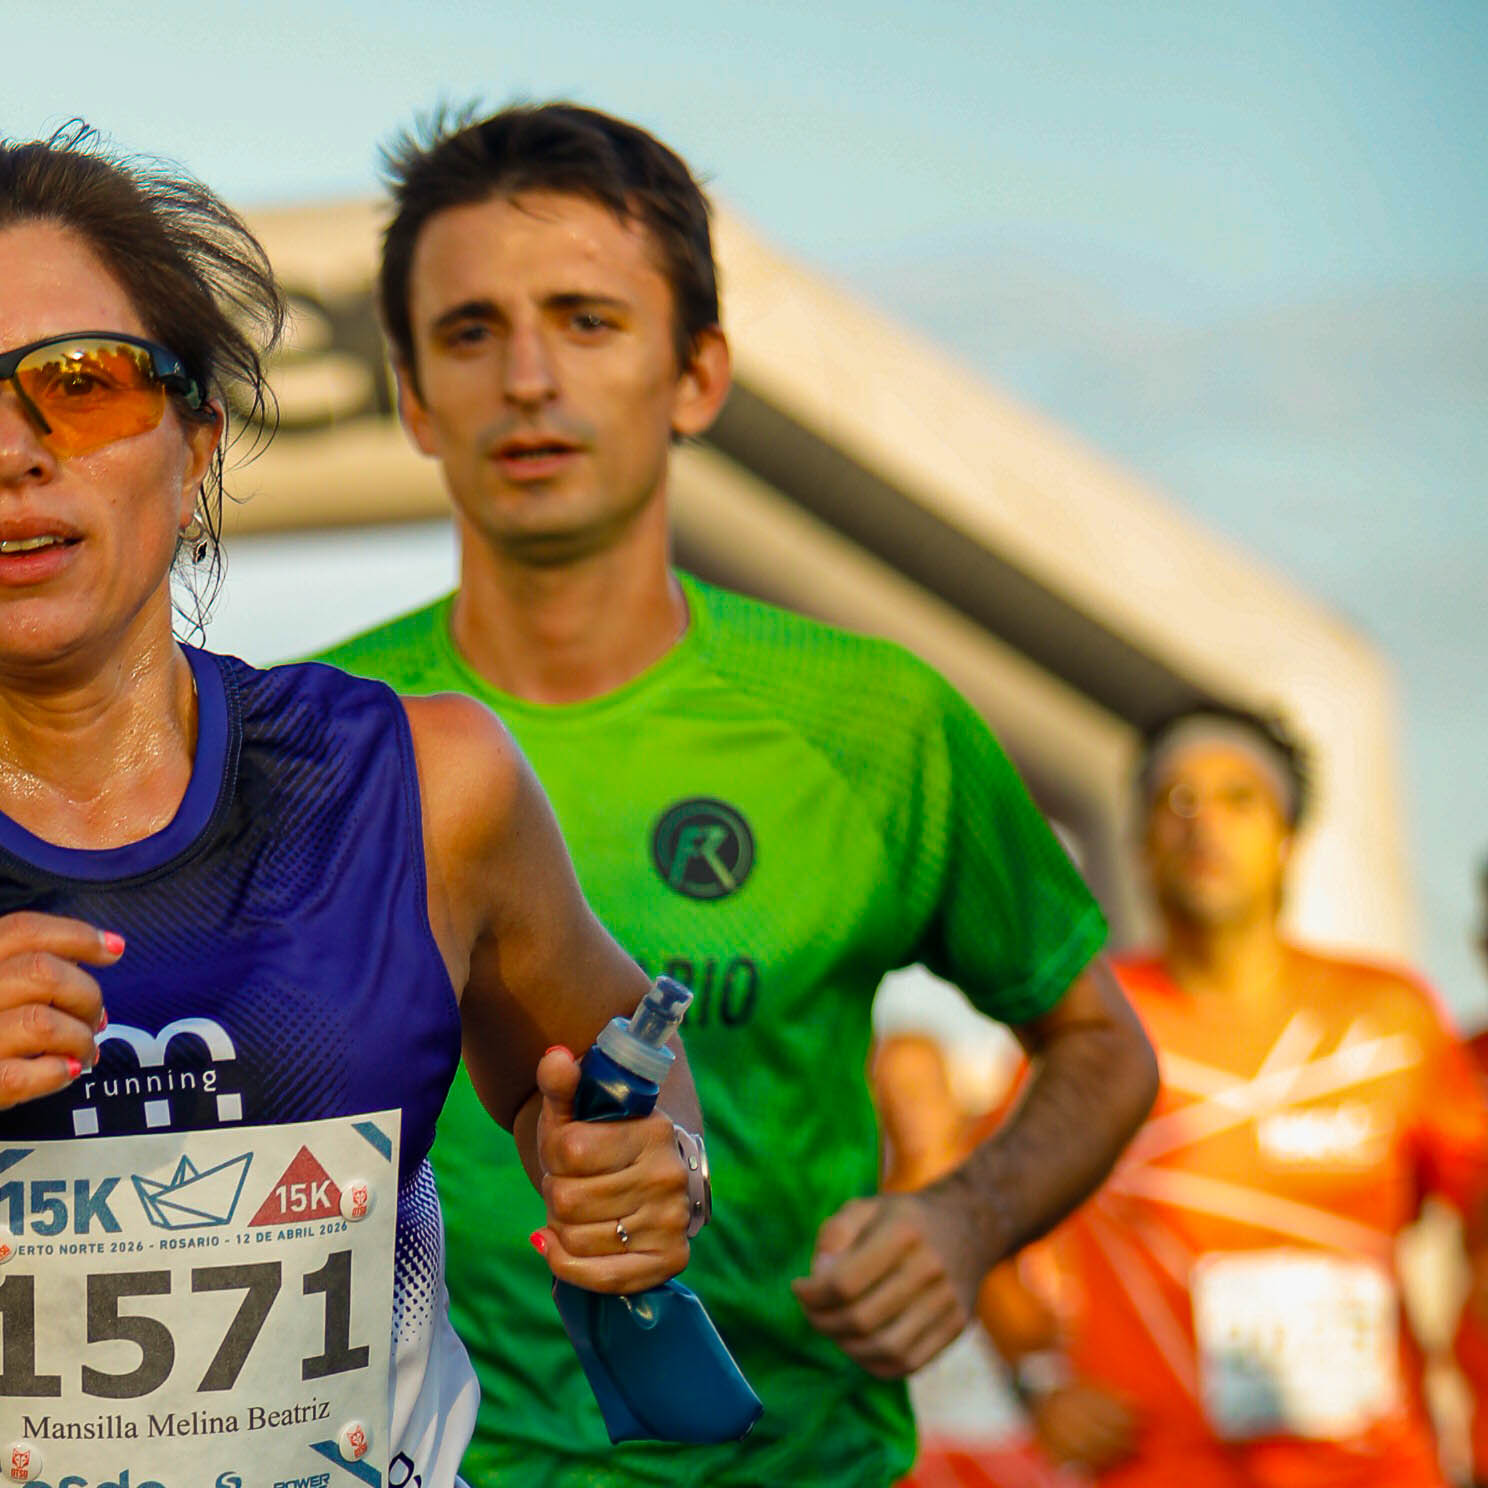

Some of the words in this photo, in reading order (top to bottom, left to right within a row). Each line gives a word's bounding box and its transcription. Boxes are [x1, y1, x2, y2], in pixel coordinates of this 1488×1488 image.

[85, 1069, 217, 1099] running
[0, 1177, 123, 1236] 15K
[275, 1180, 332, 1214] 15K
[14, 1243, 54, 1256] ERTO
[59, 1242, 105, 1255] NORTE
[110, 1241, 144, 1253] 2026
[159, 1236, 220, 1250] ROSARIO
[236, 1233, 251, 1244] 12
[256, 1231, 272, 1243] DE
[277, 1227, 315, 1241] ABRIL
[319, 1221, 348, 1236] 2026
[22, 1415, 138, 1440] Mansilla
[147, 1410, 239, 1438] Melina
[247, 1397, 331, 1431] Beatriz
